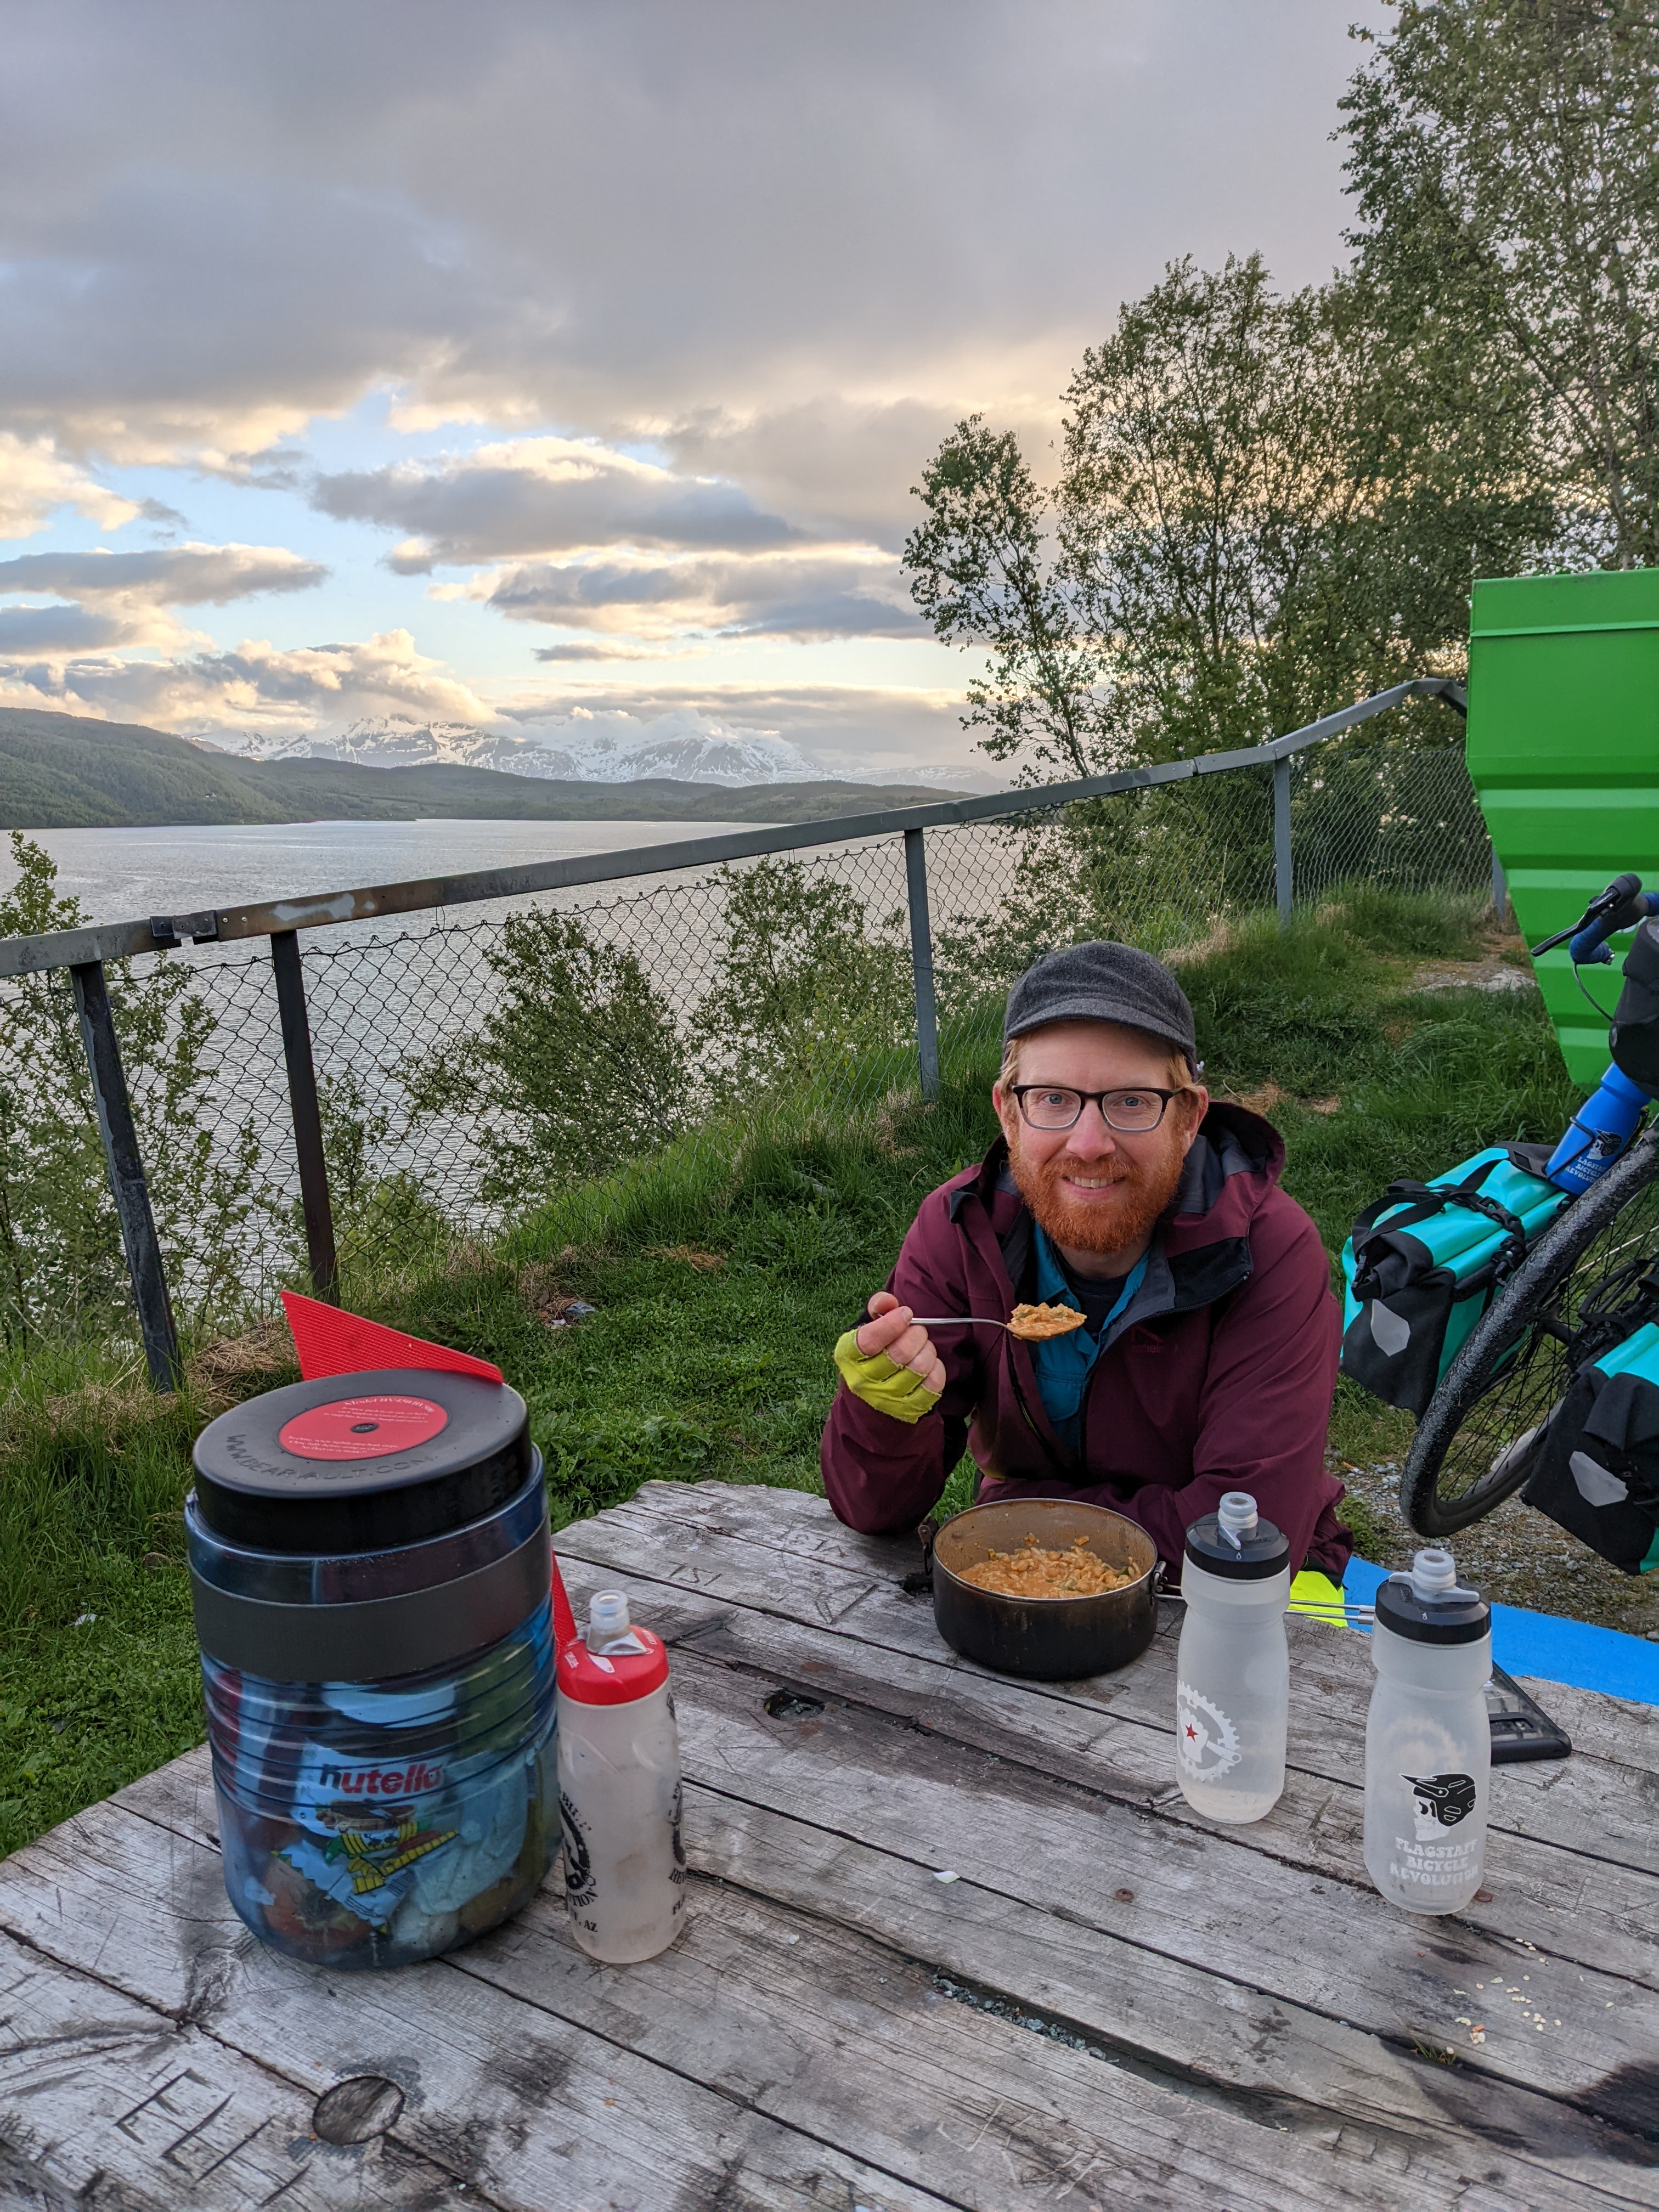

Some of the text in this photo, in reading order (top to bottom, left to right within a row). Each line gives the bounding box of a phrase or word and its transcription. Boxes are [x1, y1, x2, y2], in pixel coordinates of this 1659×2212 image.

[319, 1758, 443, 1794] nutella
[1395, 1837, 1477, 1858] FLAGSTAFF
[1390, 1861, 1478, 1886] REVOLUTION
[1406, 1855, 1469, 1872] BICYCLE
[584, 1919, 598, 1933] AZ
